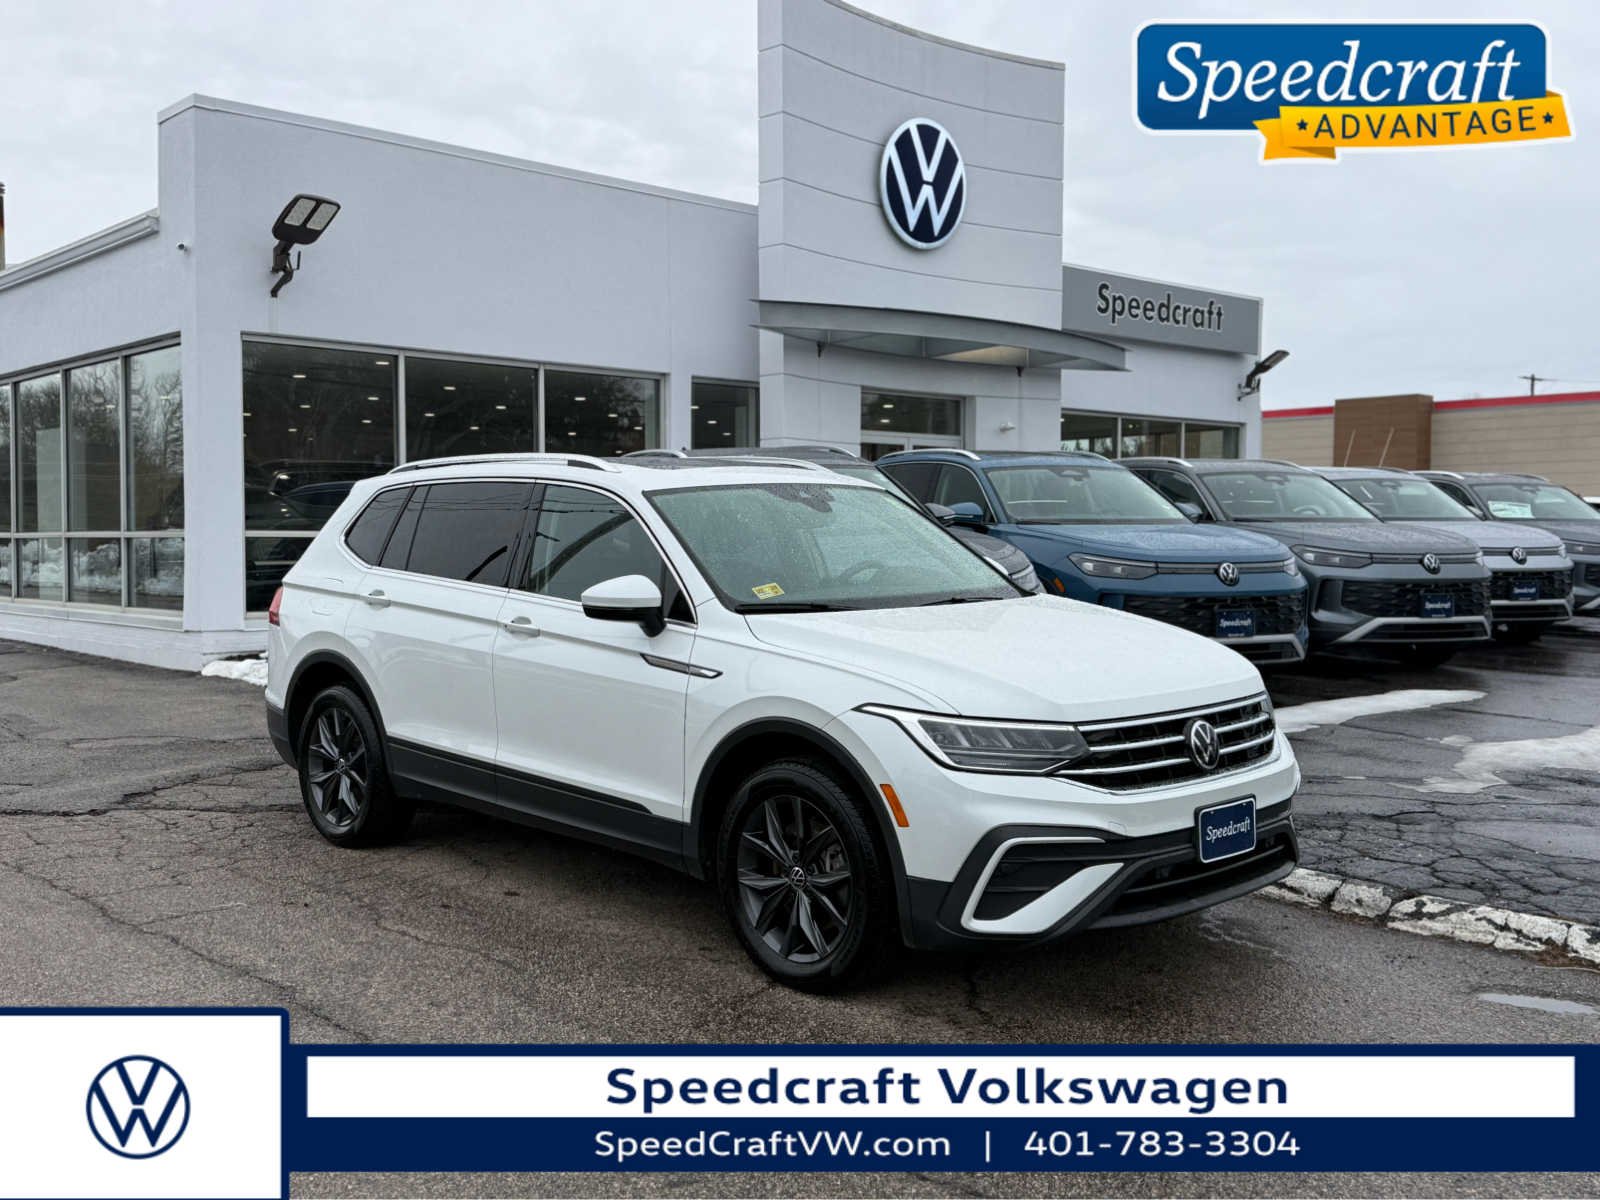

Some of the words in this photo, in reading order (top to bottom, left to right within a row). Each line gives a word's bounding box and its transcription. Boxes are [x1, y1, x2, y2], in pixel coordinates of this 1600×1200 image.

[880, 117, 966, 249] VW
[1096, 282, 1224, 332] Speedcraft
[1205, 816, 1251, 843] Speedcraft
